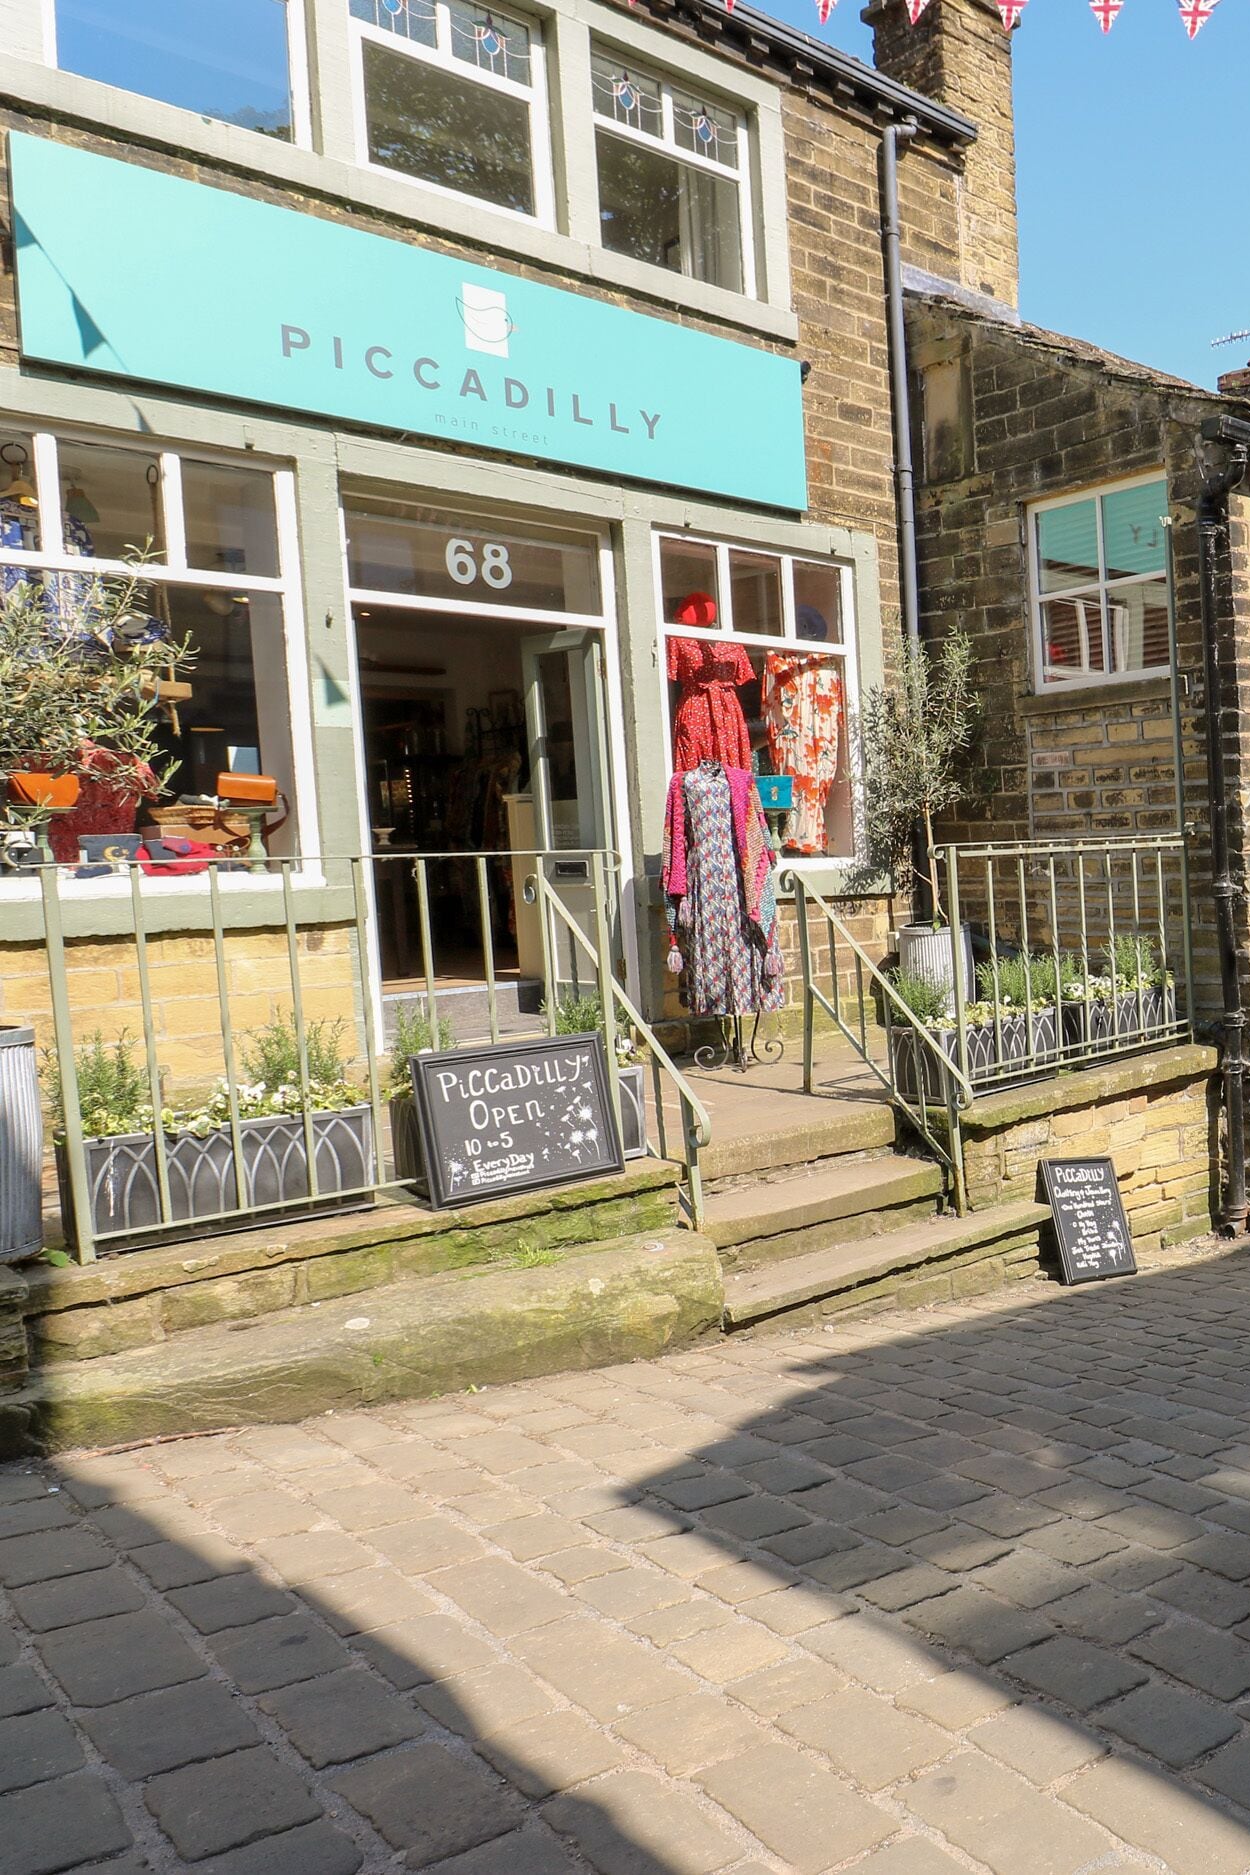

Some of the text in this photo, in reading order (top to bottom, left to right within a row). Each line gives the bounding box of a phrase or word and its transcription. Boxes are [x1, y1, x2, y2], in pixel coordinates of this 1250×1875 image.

[280, 323, 662, 439] PICCADILLY
[434, 412, 549, 446] main street
[445, 537, 513, 590] 68
[464, 1132, 513, 1156] 10 to 5
